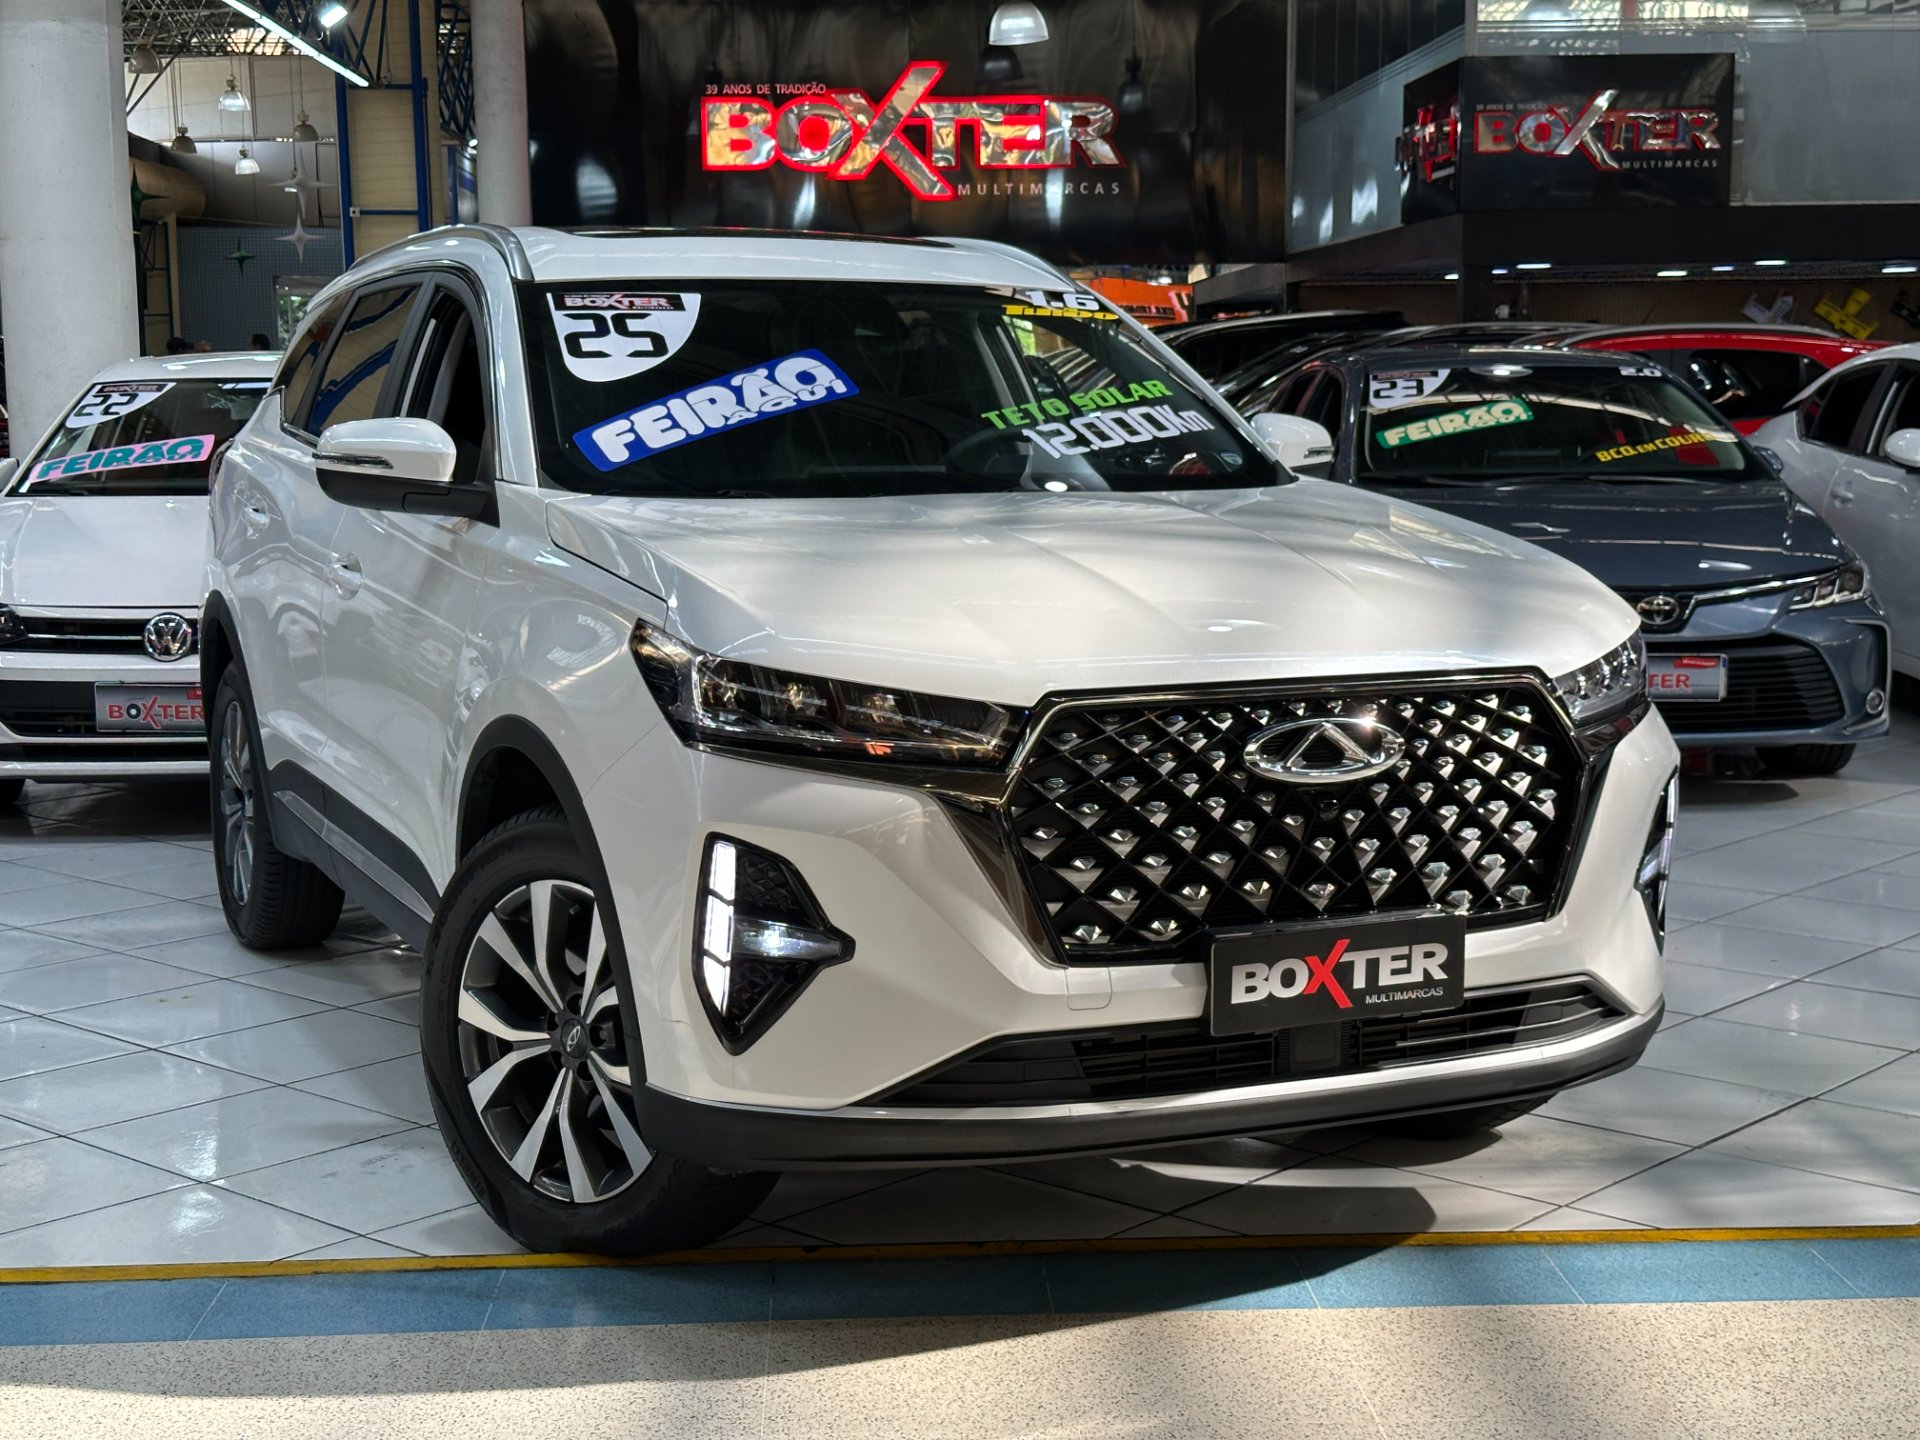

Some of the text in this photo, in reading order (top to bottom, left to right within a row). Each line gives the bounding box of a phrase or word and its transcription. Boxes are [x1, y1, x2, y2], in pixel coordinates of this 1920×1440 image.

[704, 81, 826, 96] 39 ANOS DE TRADIÇÃO
[702, 60, 1126, 201] BOXTER
[1473, 88, 1721, 171] BOXTER
[1621, 160, 1719, 170] MULTIMARCAS
[957, 182, 1120, 196] MULTIMARCAS
[564, 292, 671, 309] BOXTER
[1025, 290, 1100, 311] 1.6
[562, 312, 669, 358] 25
[1618, 366, 1662, 377] 2.0
[1373, 379, 1424, 399] 23
[73, 393, 139, 417] 22
[592, 356, 838, 463] FEIRÃO
[981, 380, 1173, 430] TETO SOLAR
[1384, 402, 1525, 446] FEIRÃO
[37, 438, 205, 479] FEIRÃO
[1230, 938, 1449, 1009] BOXTER
[1365, 986, 1444, 1004] MULTIMARCAS
